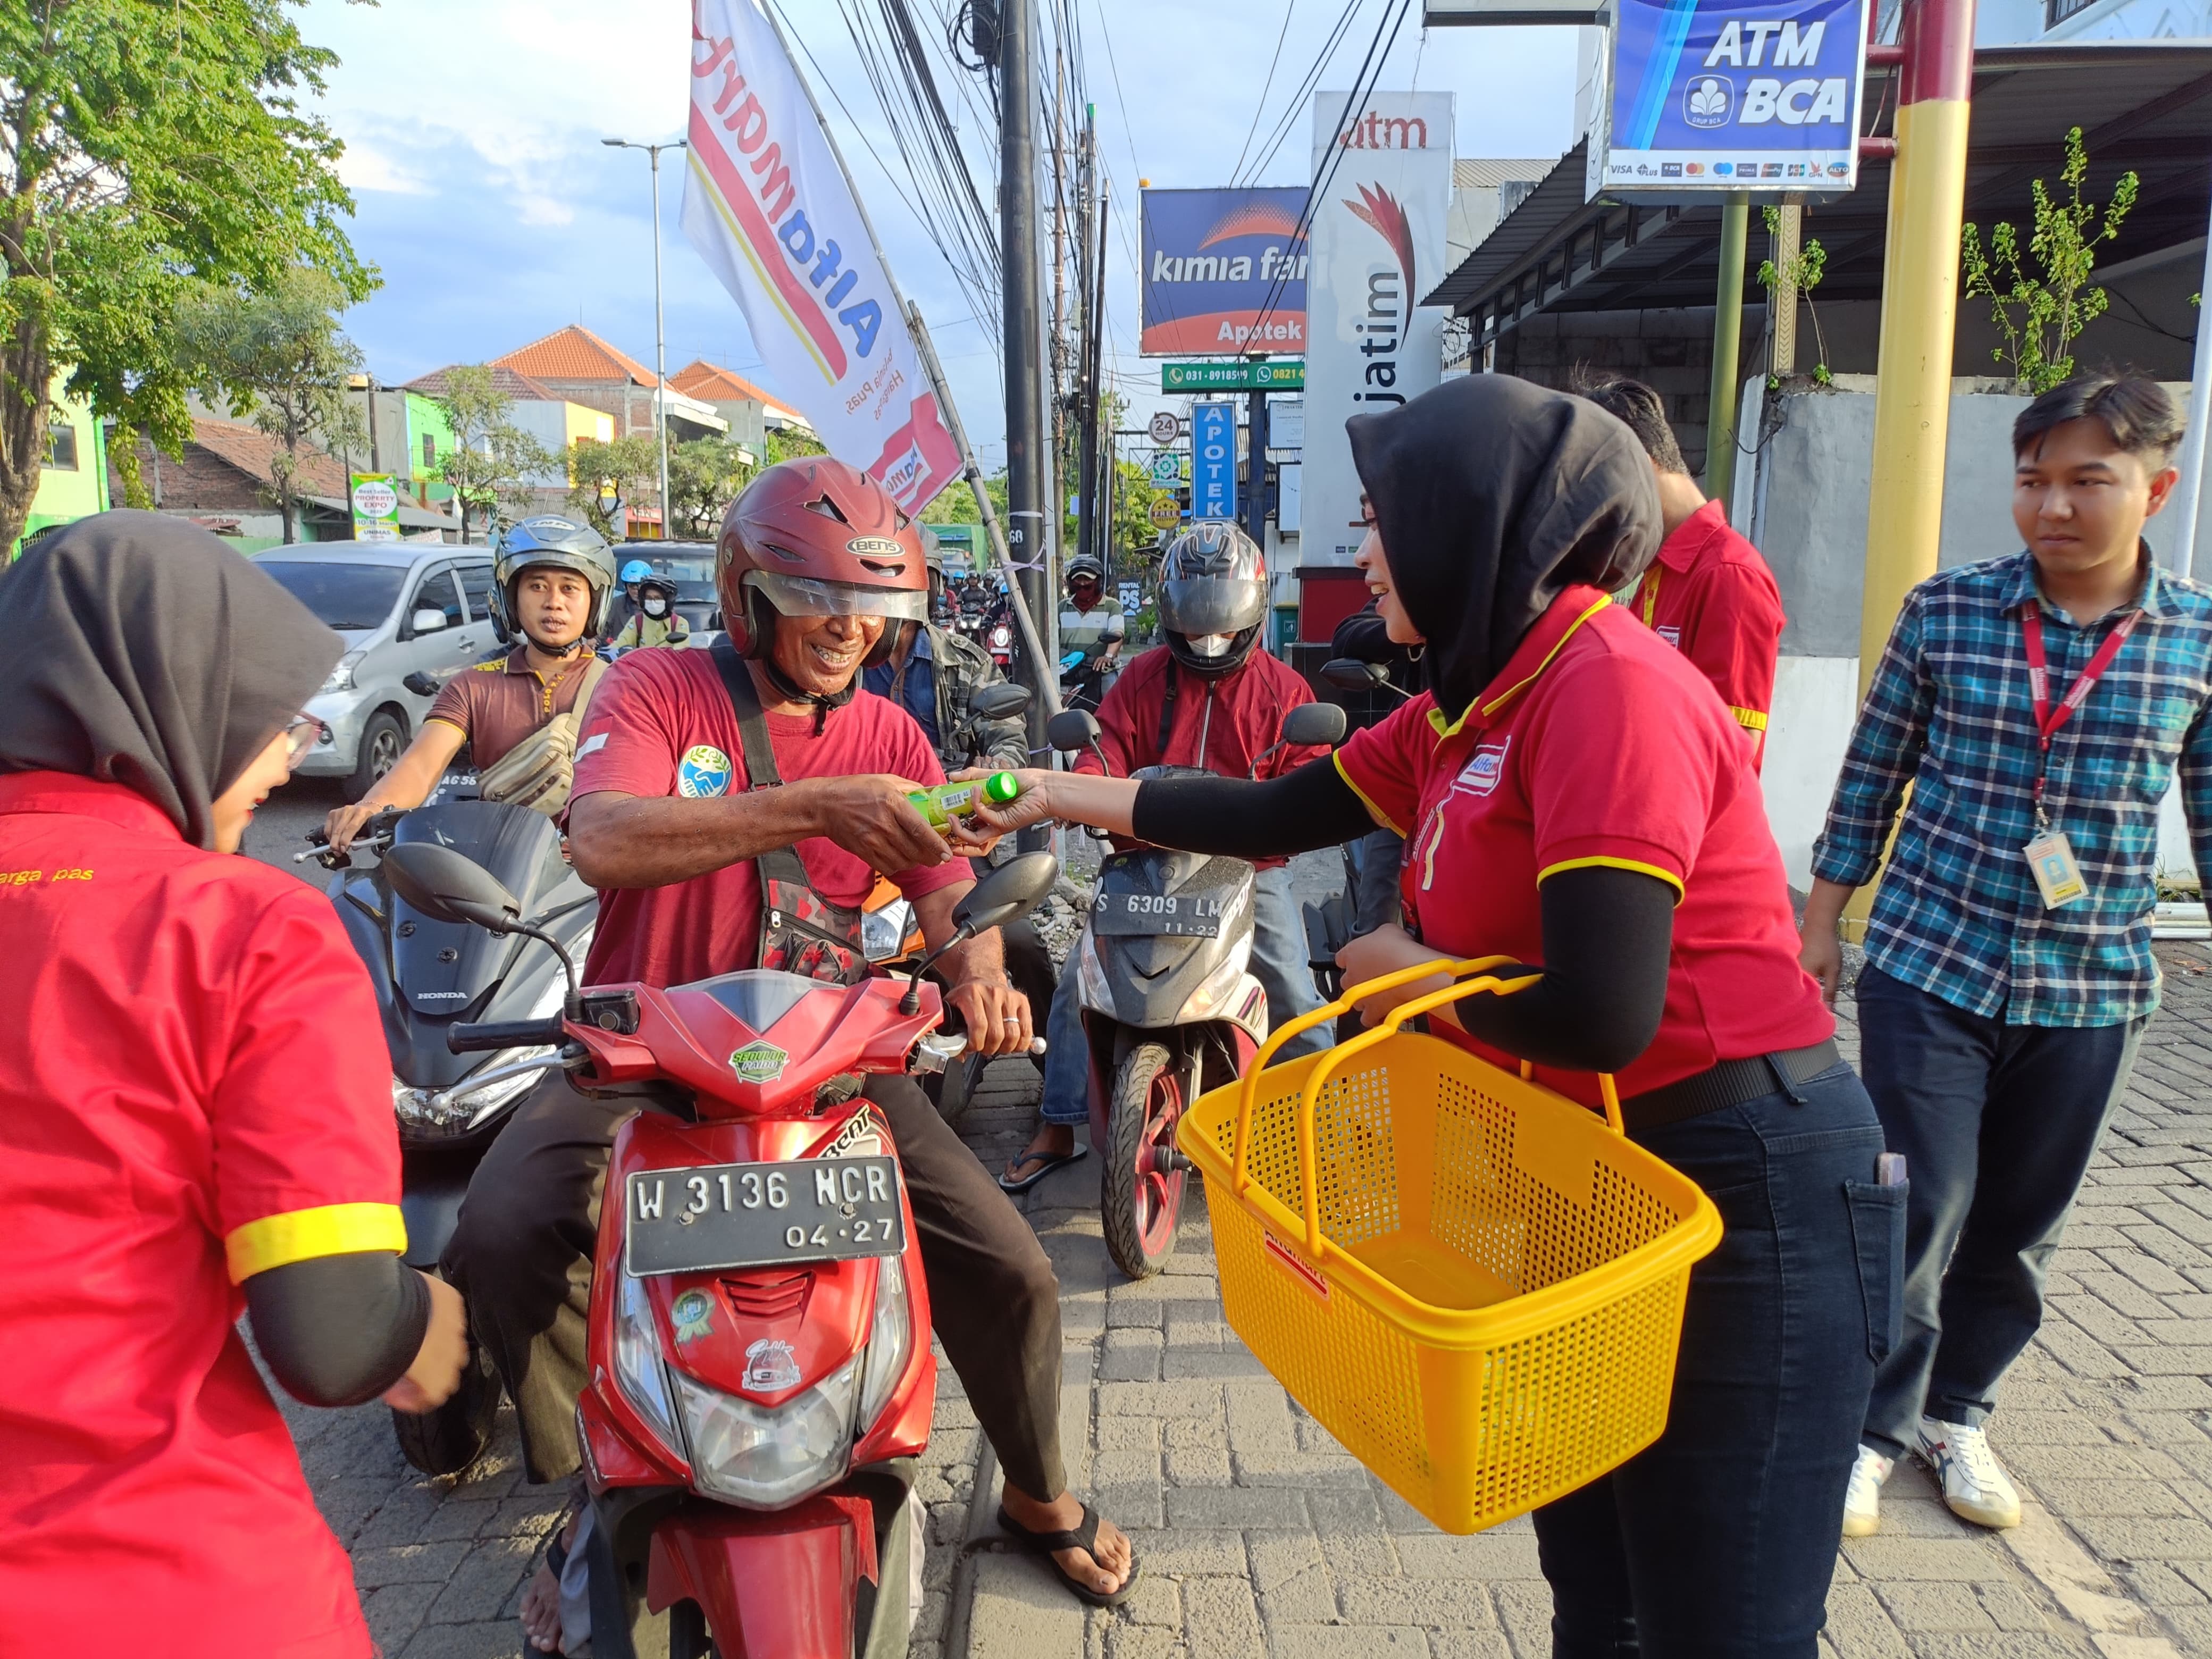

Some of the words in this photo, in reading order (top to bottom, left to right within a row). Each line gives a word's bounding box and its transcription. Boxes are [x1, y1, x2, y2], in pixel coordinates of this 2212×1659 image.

[1703, 21, 1826, 67] ATM
[1738, 78, 1846, 124] BCA
[1339, 110, 1426, 149] atm
[1610, 165, 1632, 173] VISA
[1152, 249, 1252, 282] kimia
[1217, 320, 1302, 345] Apotek
[1353, 272, 1406, 406] jatim
[1273, 369, 1296, 379] 0821
[1155, 420, 1173, 431] 24
[1203, 407, 1225, 517] APOTEK
[856, 541, 896, 551] BENS
[1119, 590, 1139, 609] PS
[543, 688, 552, 713] POLO
[441, 775, 459, 785] AG
[52, 868, 94, 882] pas
[1096, 893, 1108, 912] S
[1127, 894, 1177, 914] 6309
[1195, 898, 1222, 918] LM
[733, 1051, 786, 1063] SEDULUR
[637, 1180, 664, 1220] W
[687, 1171, 787, 1214] 3136
[815, 1165, 887, 1205] NCR
[576, 1404, 600, 1485] HONDA
